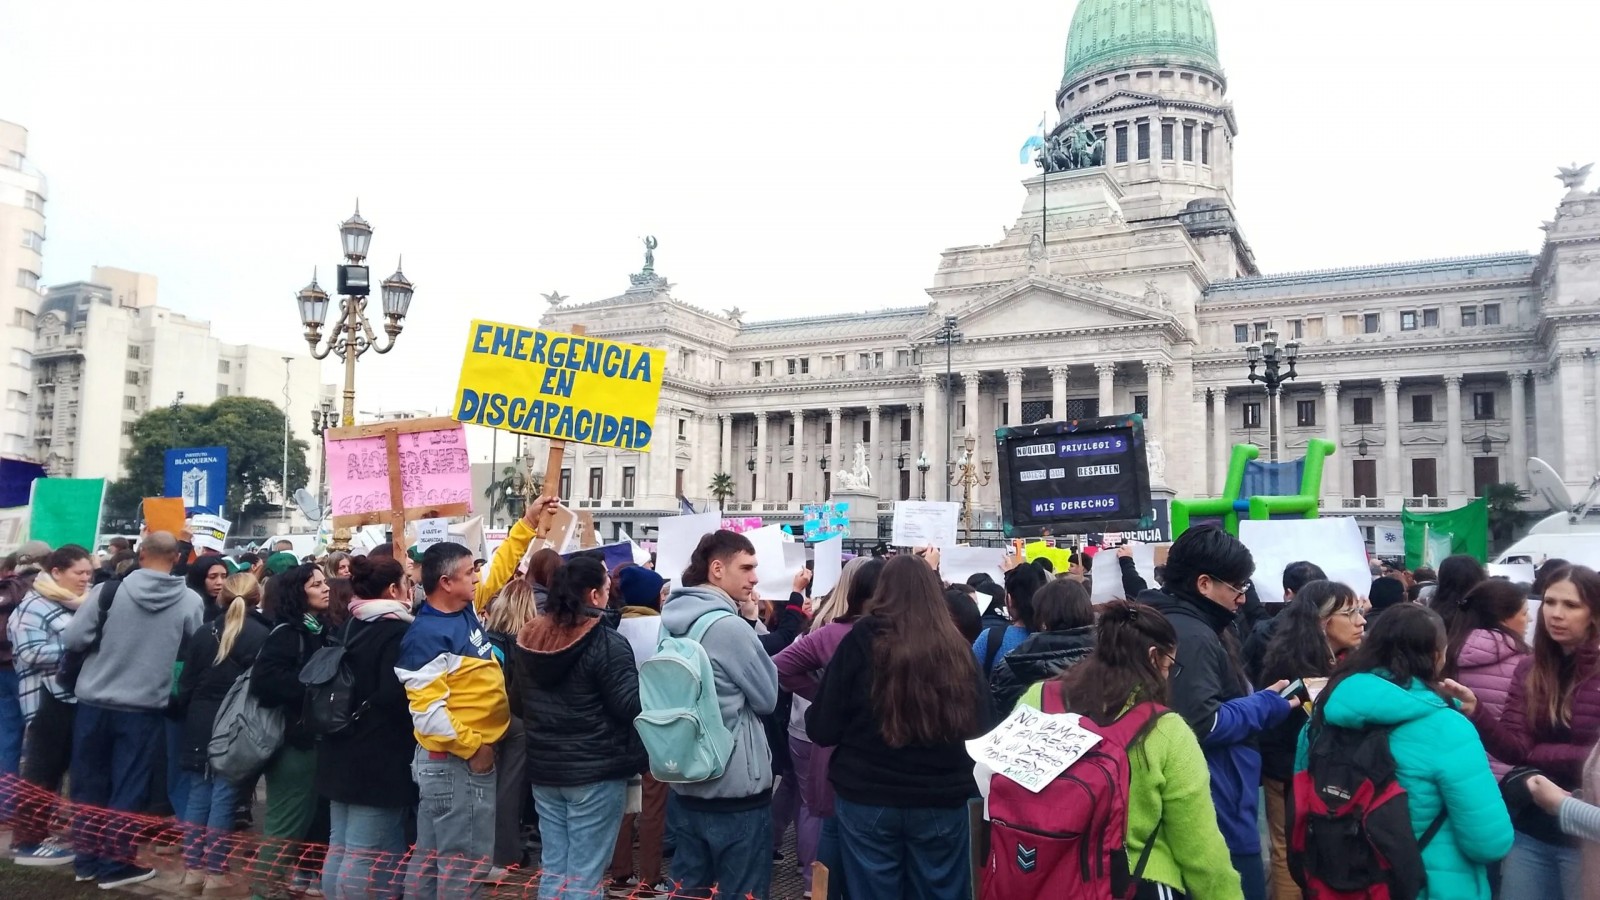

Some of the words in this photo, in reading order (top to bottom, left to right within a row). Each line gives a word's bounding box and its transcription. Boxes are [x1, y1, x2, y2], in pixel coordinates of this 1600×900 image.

[472, 324, 651, 382] EMERGENCIA
[540, 367, 576, 398] EN
[458, 388, 652, 449] DISCAPACIDAD
[174, 456, 218, 465] BLANQUERNA
[1078, 464, 1119, 476] RESPETEN
[1035, 503, 1055, 512] MIS
[1061, 498, 1115, 511] DERECHOS
[1014, 711, 1039, 727] NO
[1040, 720, 1087, 742] VAMOS
[1013, 729, 1081, 760] ENTREGAR
